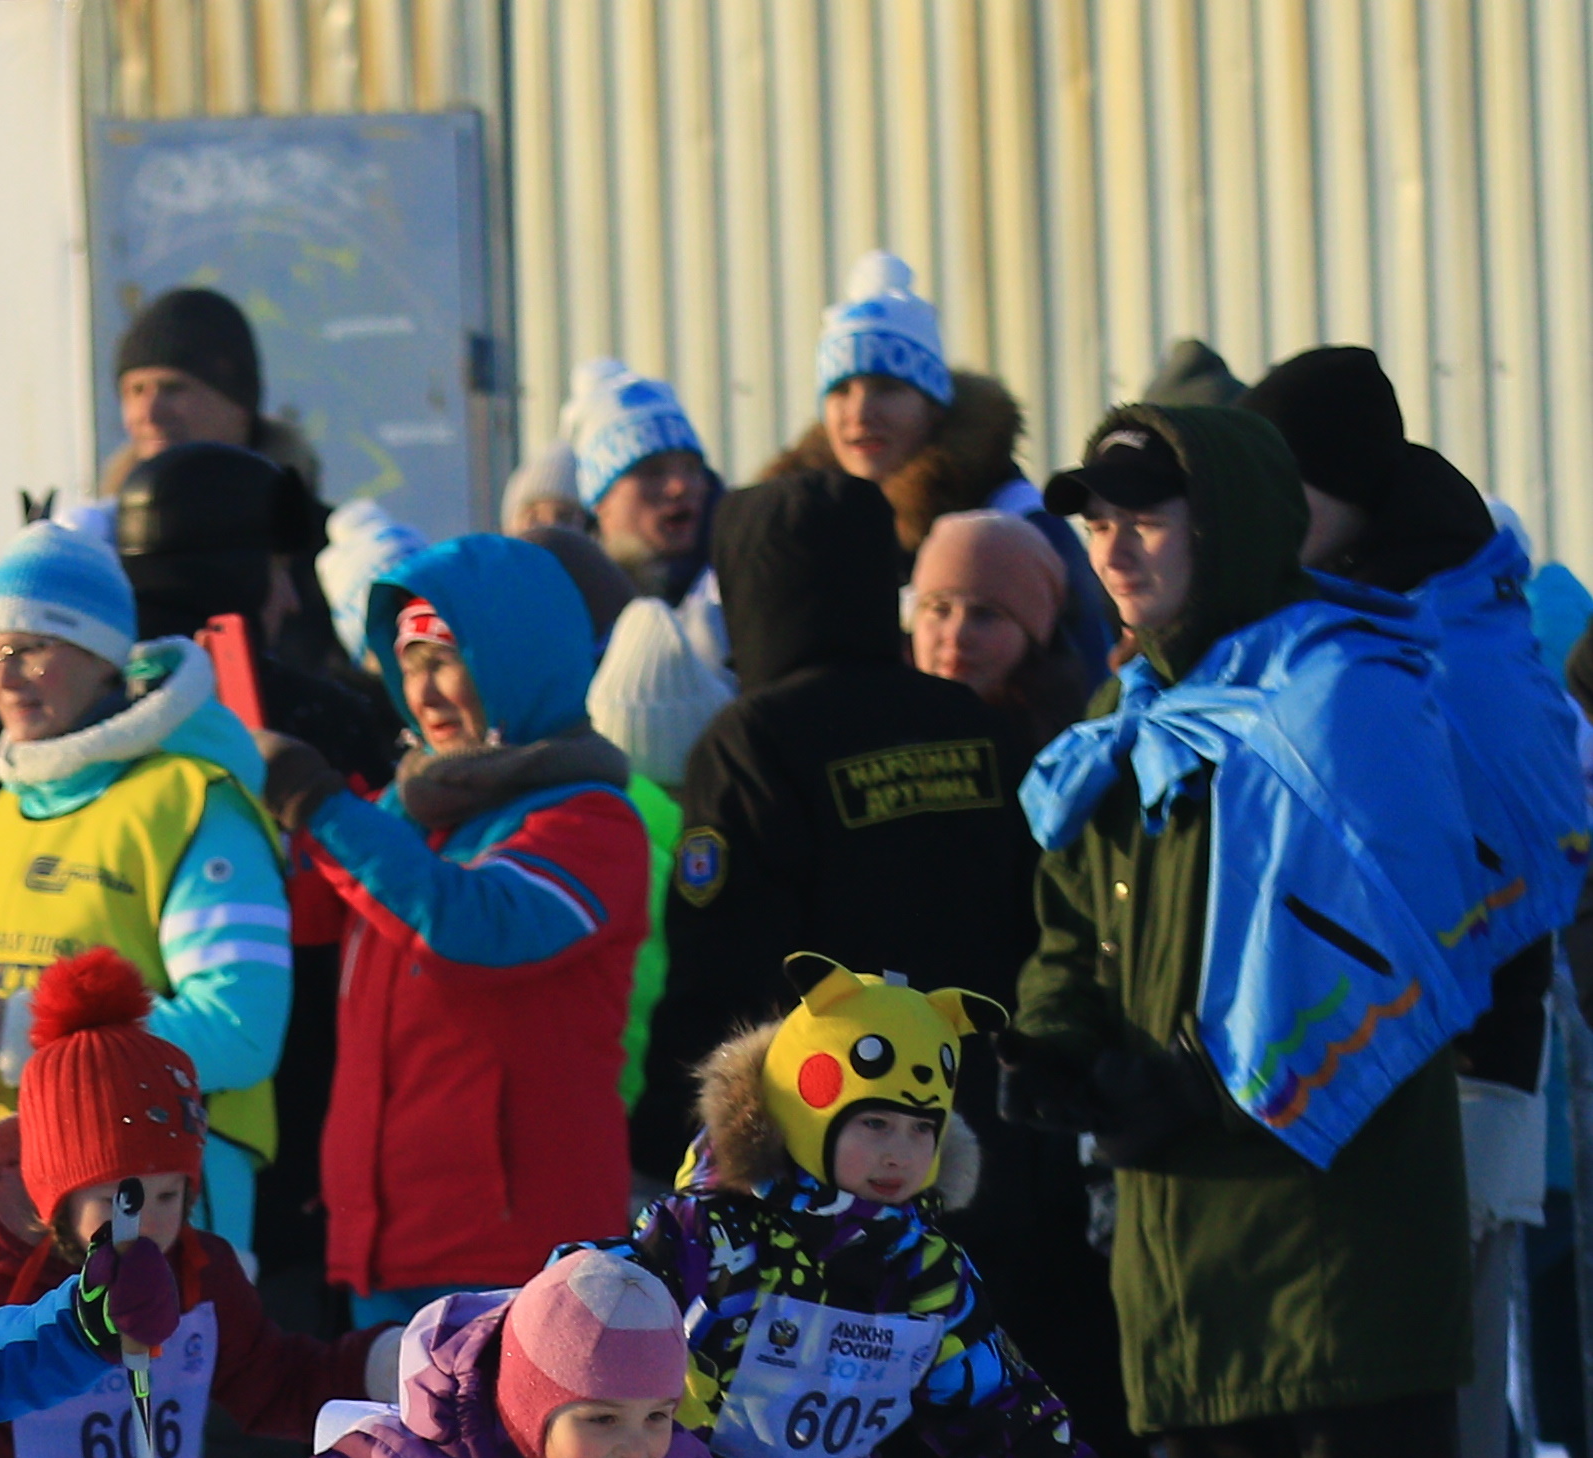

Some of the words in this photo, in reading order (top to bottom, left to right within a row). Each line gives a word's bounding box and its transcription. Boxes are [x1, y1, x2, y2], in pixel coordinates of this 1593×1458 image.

[831, 1321, 894, 1345] ЛЫЖНЯ
[828, 1337, 892, 1361] РОССИИ
[822, 1356, 887, 1382] 2024
[785, 1390, 896, 1455] 605
